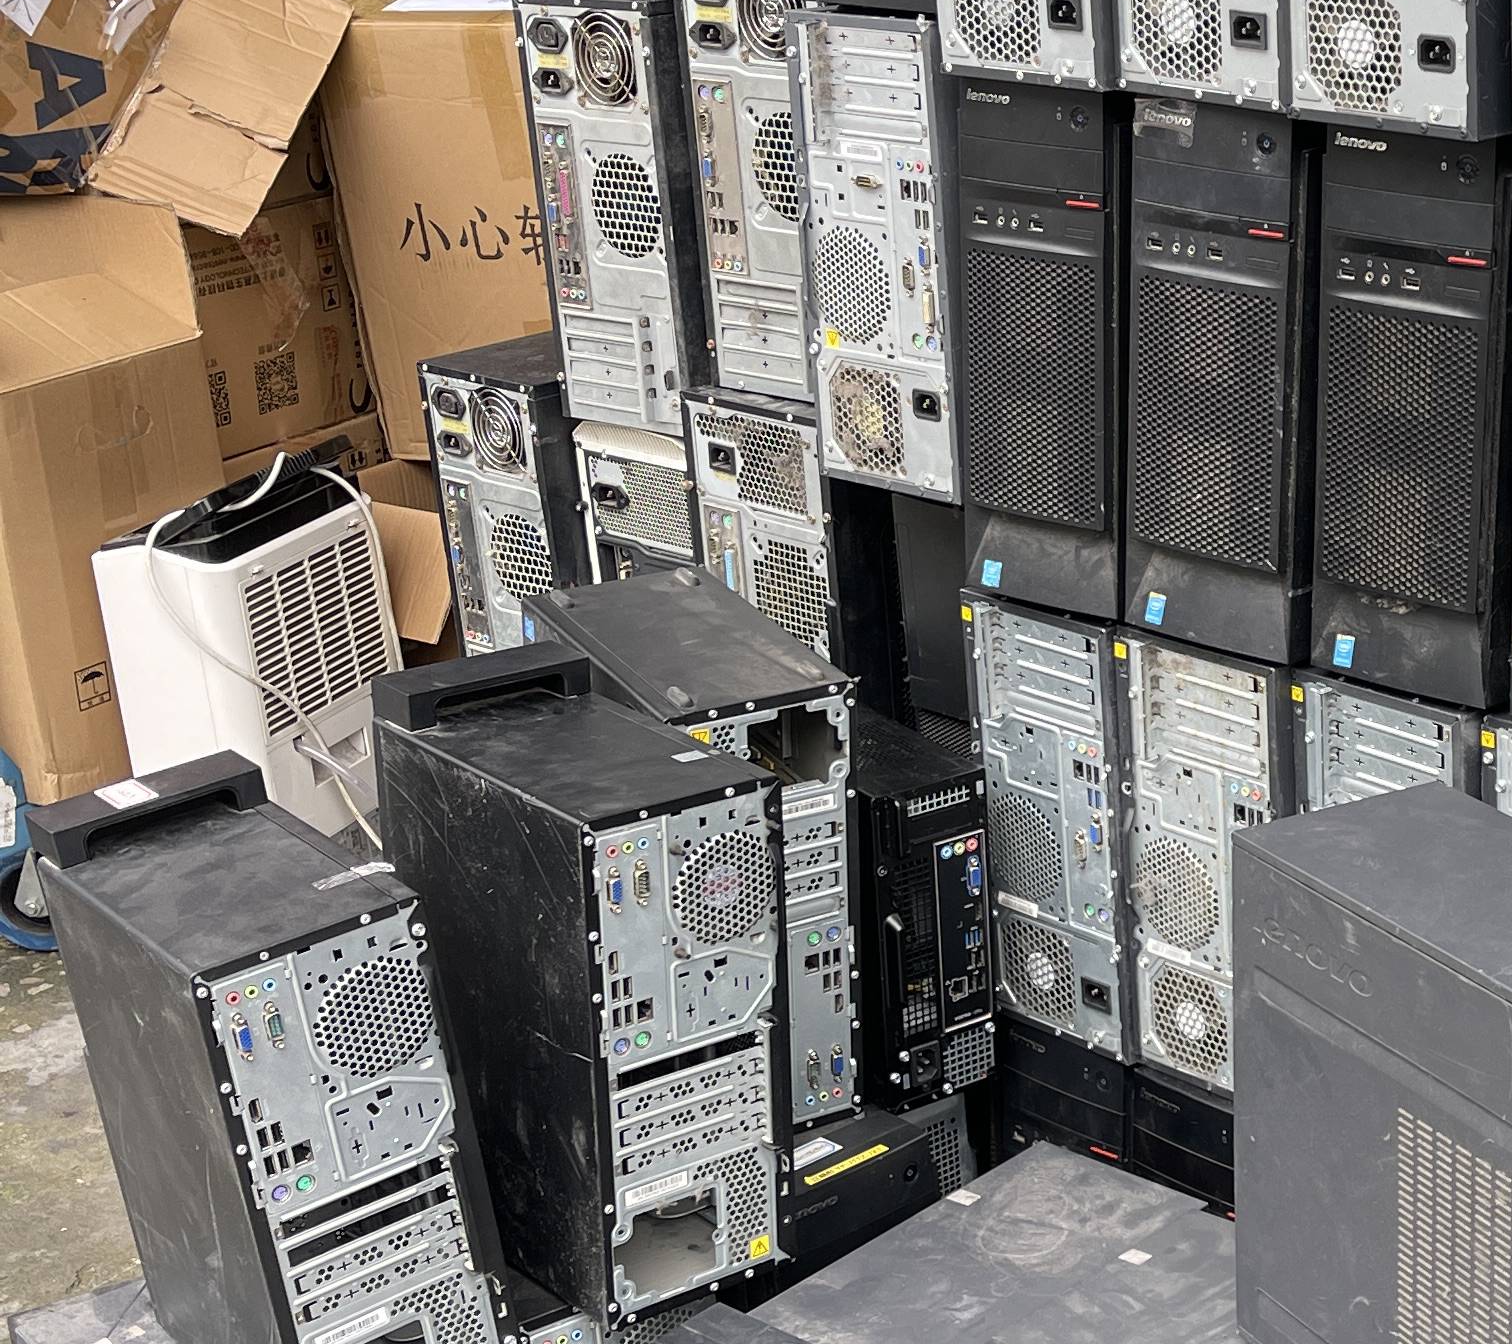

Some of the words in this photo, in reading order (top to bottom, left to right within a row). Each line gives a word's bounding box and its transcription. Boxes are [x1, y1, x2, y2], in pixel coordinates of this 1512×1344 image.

[967, 88, 1010, 105] lenovo
[1144, 109, 1191, 127] lenovo
[1334, 131, 1387, 152] lenovo
